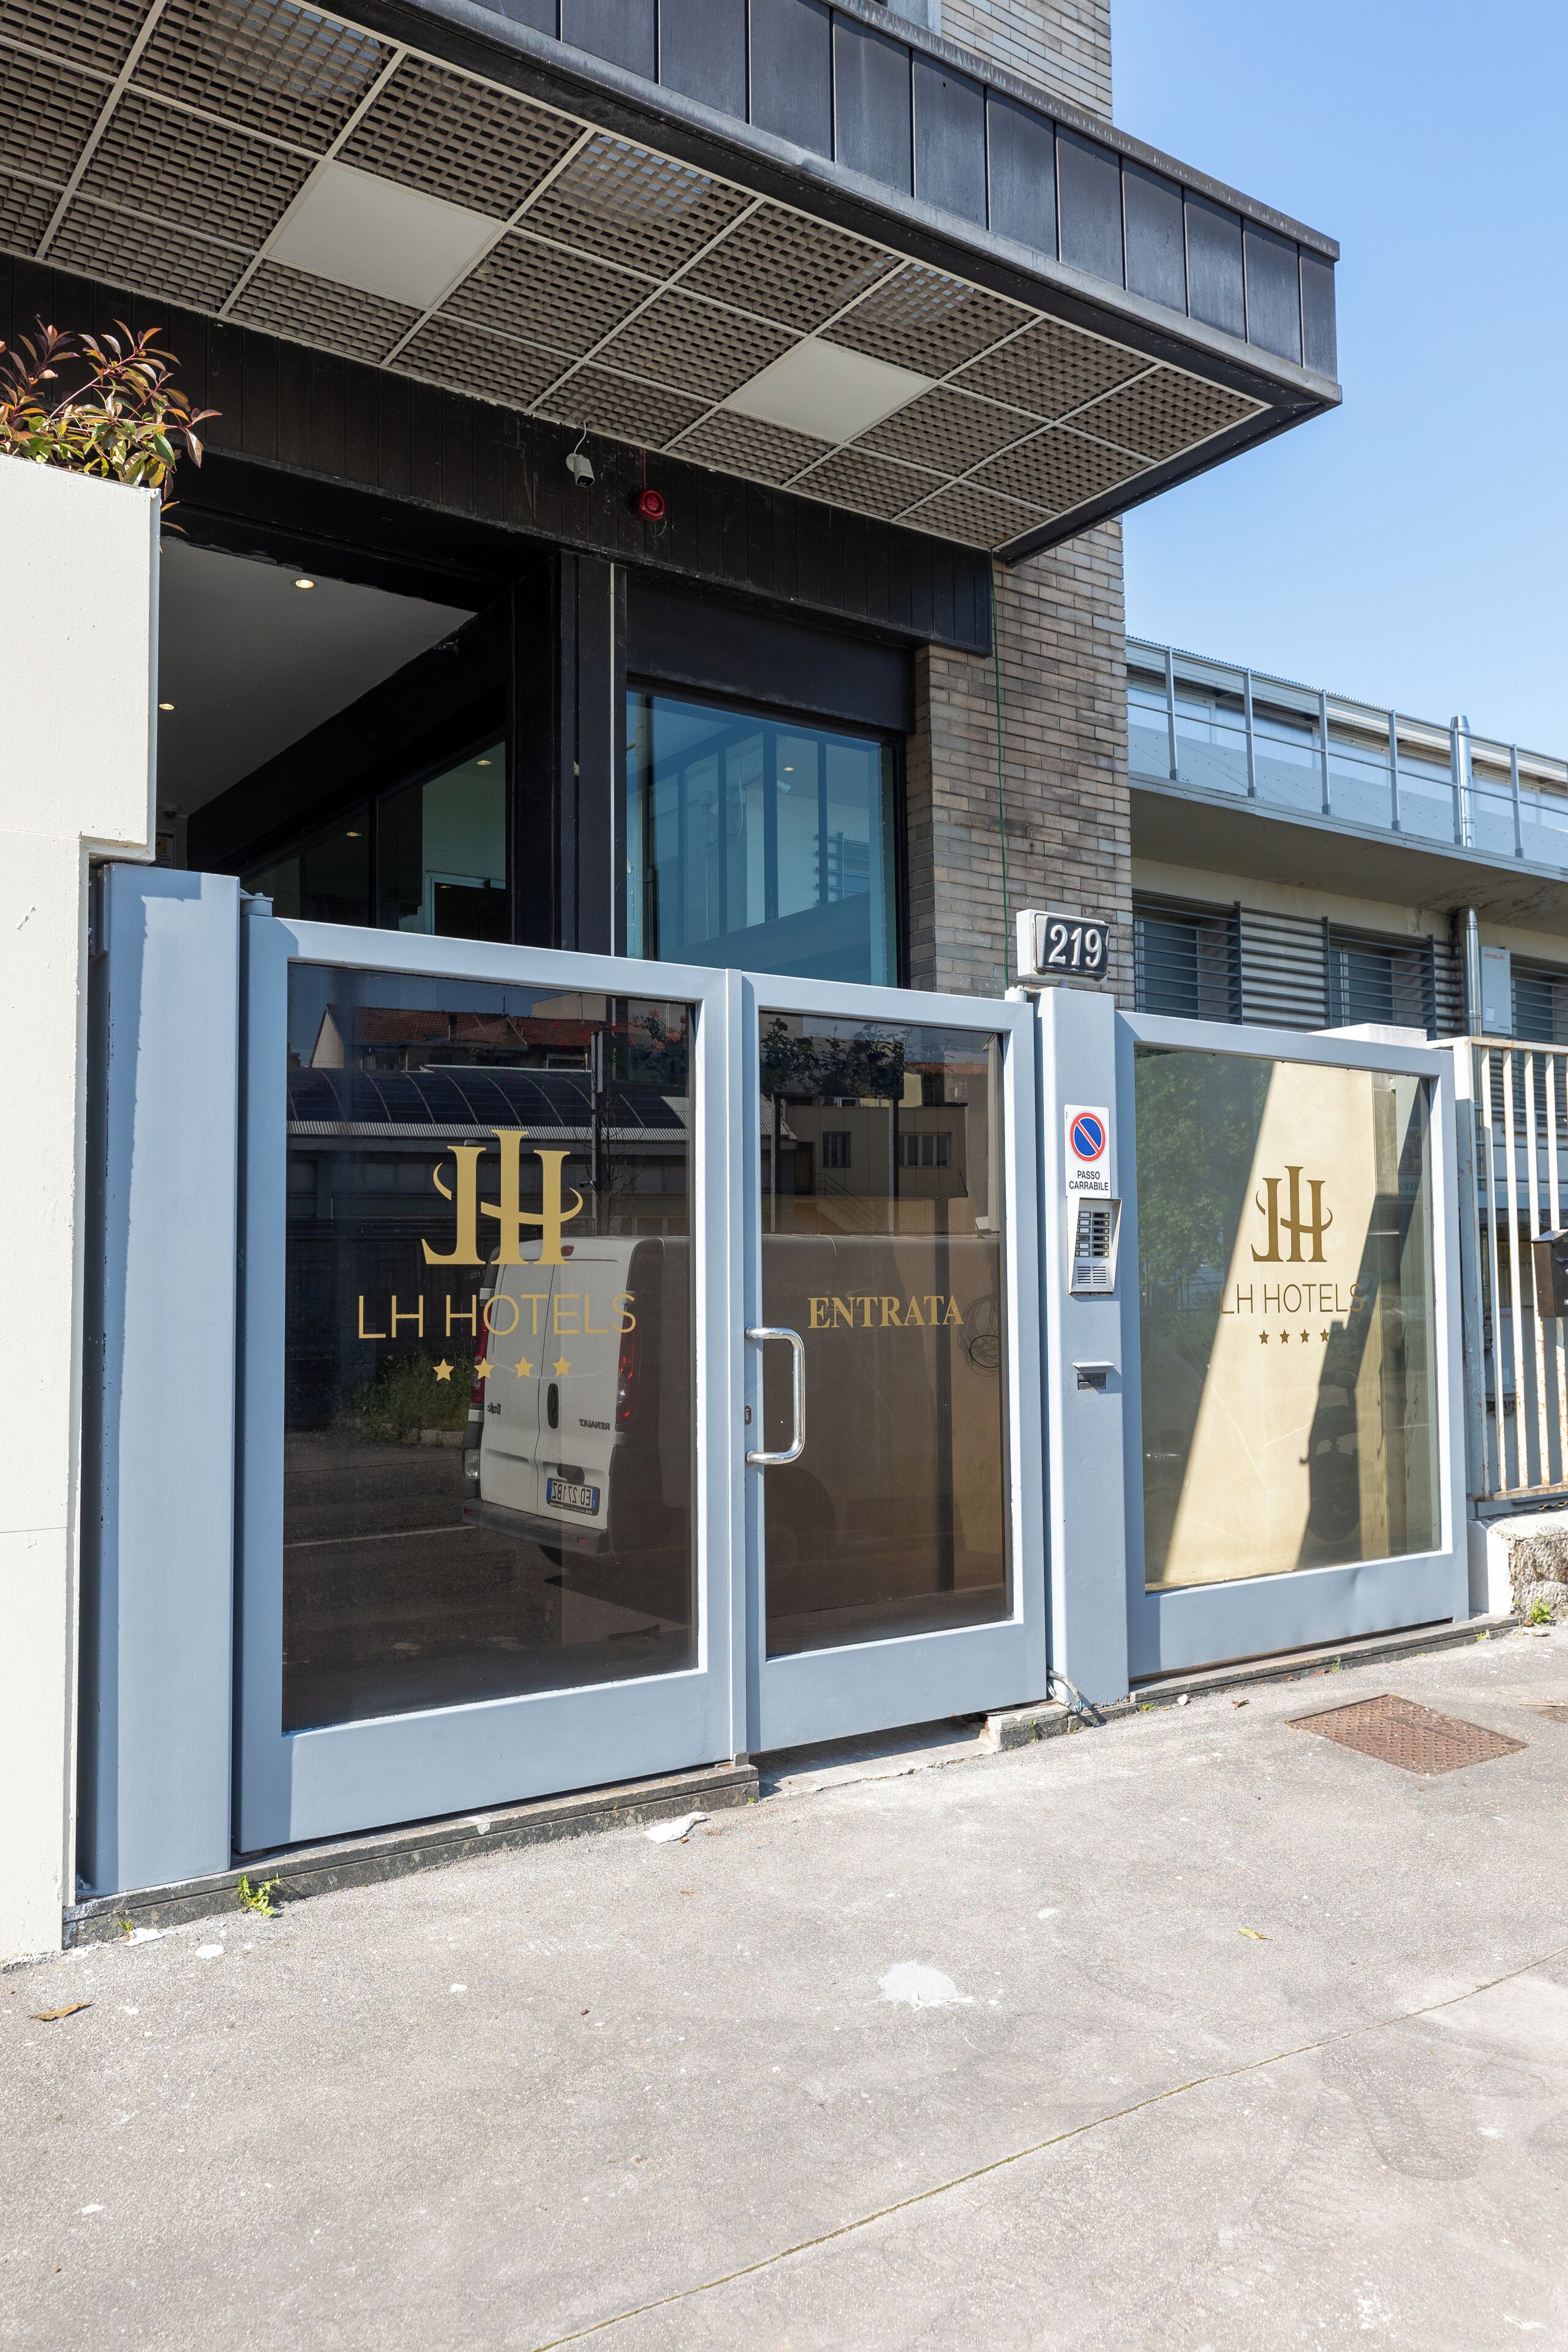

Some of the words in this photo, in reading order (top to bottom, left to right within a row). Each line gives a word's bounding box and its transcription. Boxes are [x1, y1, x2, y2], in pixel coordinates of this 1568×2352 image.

[1049, 924, 1102, 967] 219
[1069, 1180, 1109, 1191] CARRABILE
[1077, 1170, 1101, 1180] PASSO
[807, 1295, 965, 1329] ENTRATA
[1220, 1283, 1253, 1314] LH
[1264, 1283, 1363, 1313] HOTELS
[359, 1294, 424, 1339] LH
[446, 1294, 636, 1337] HOTELS
